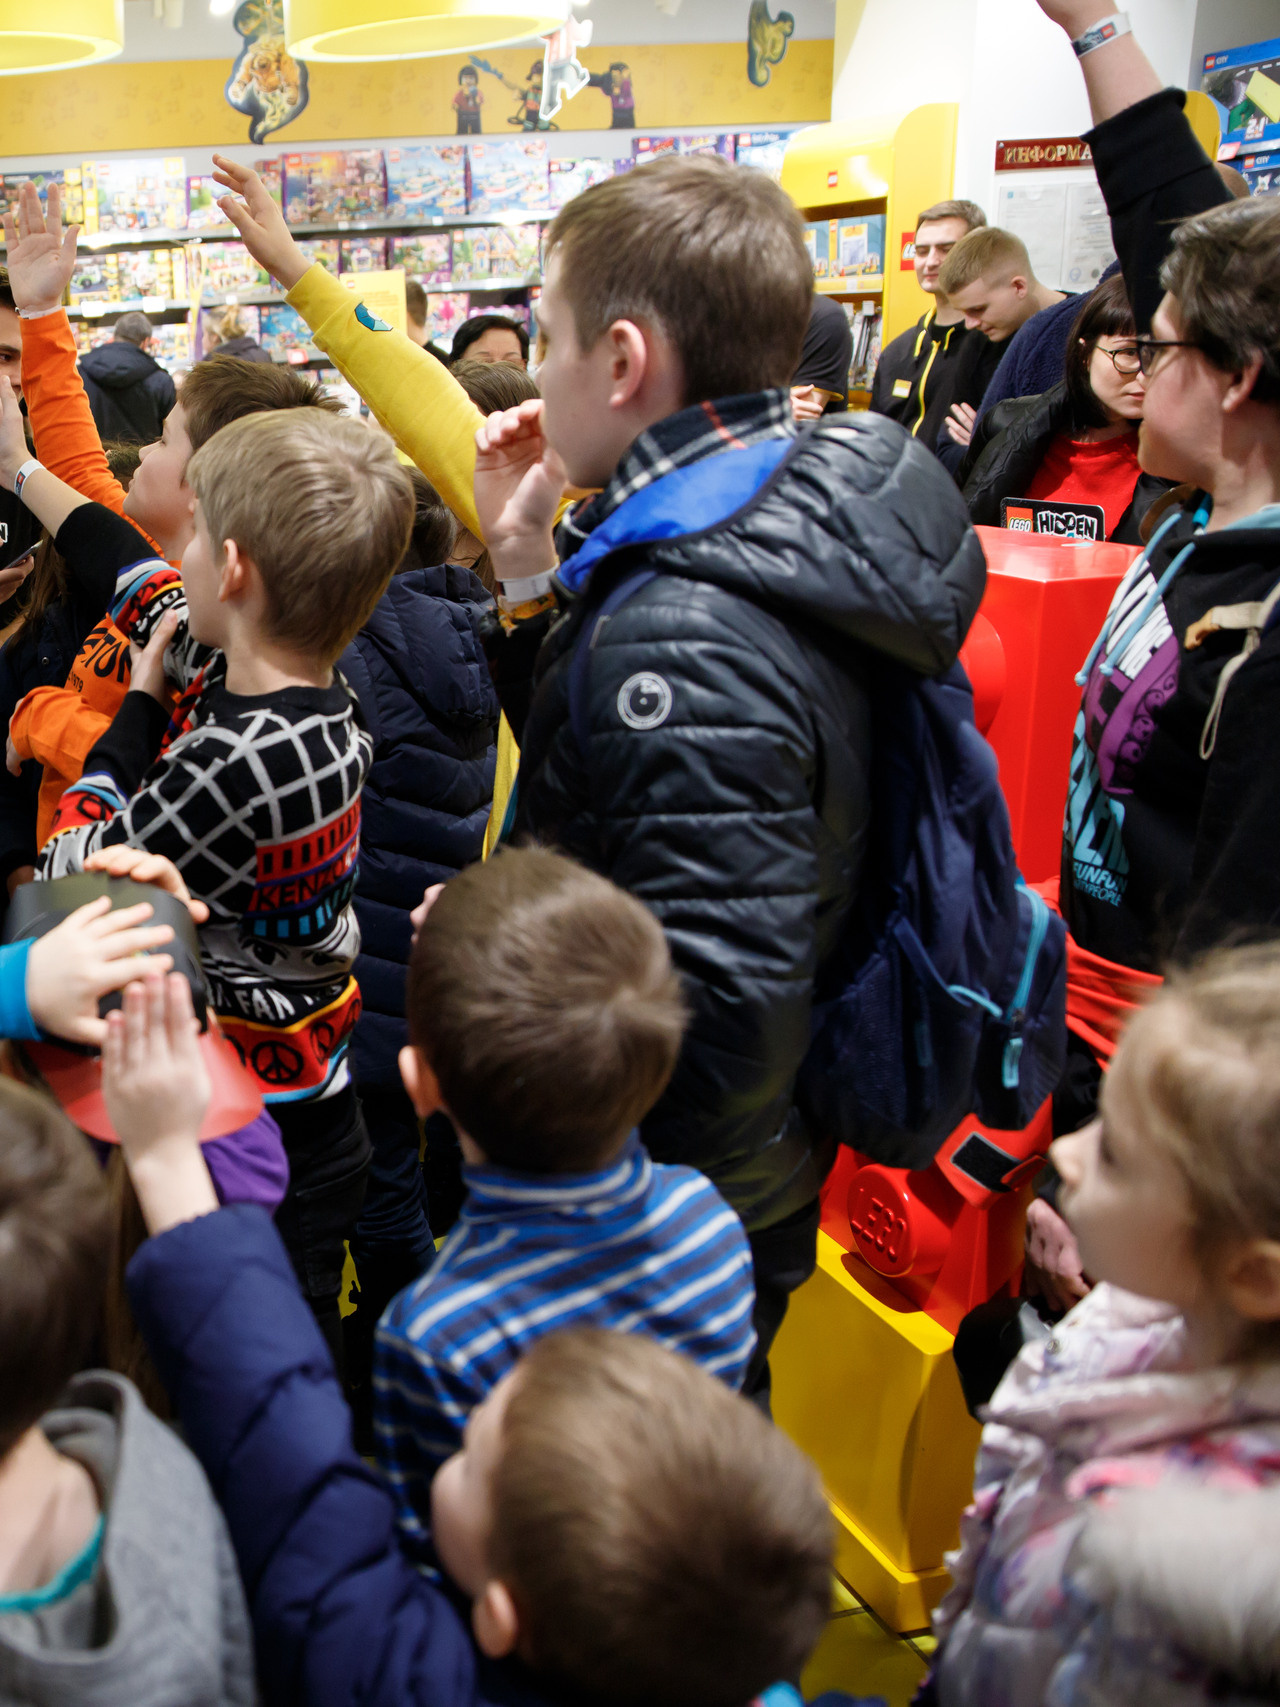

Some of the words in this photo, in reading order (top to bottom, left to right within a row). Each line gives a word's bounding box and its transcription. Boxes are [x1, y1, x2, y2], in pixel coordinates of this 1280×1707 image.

[1008, 518, 1033, 533] LEGO
[1036, 510, 1098, 542] HIDDEN
[850, 1187, 907, 1263] LEGO
